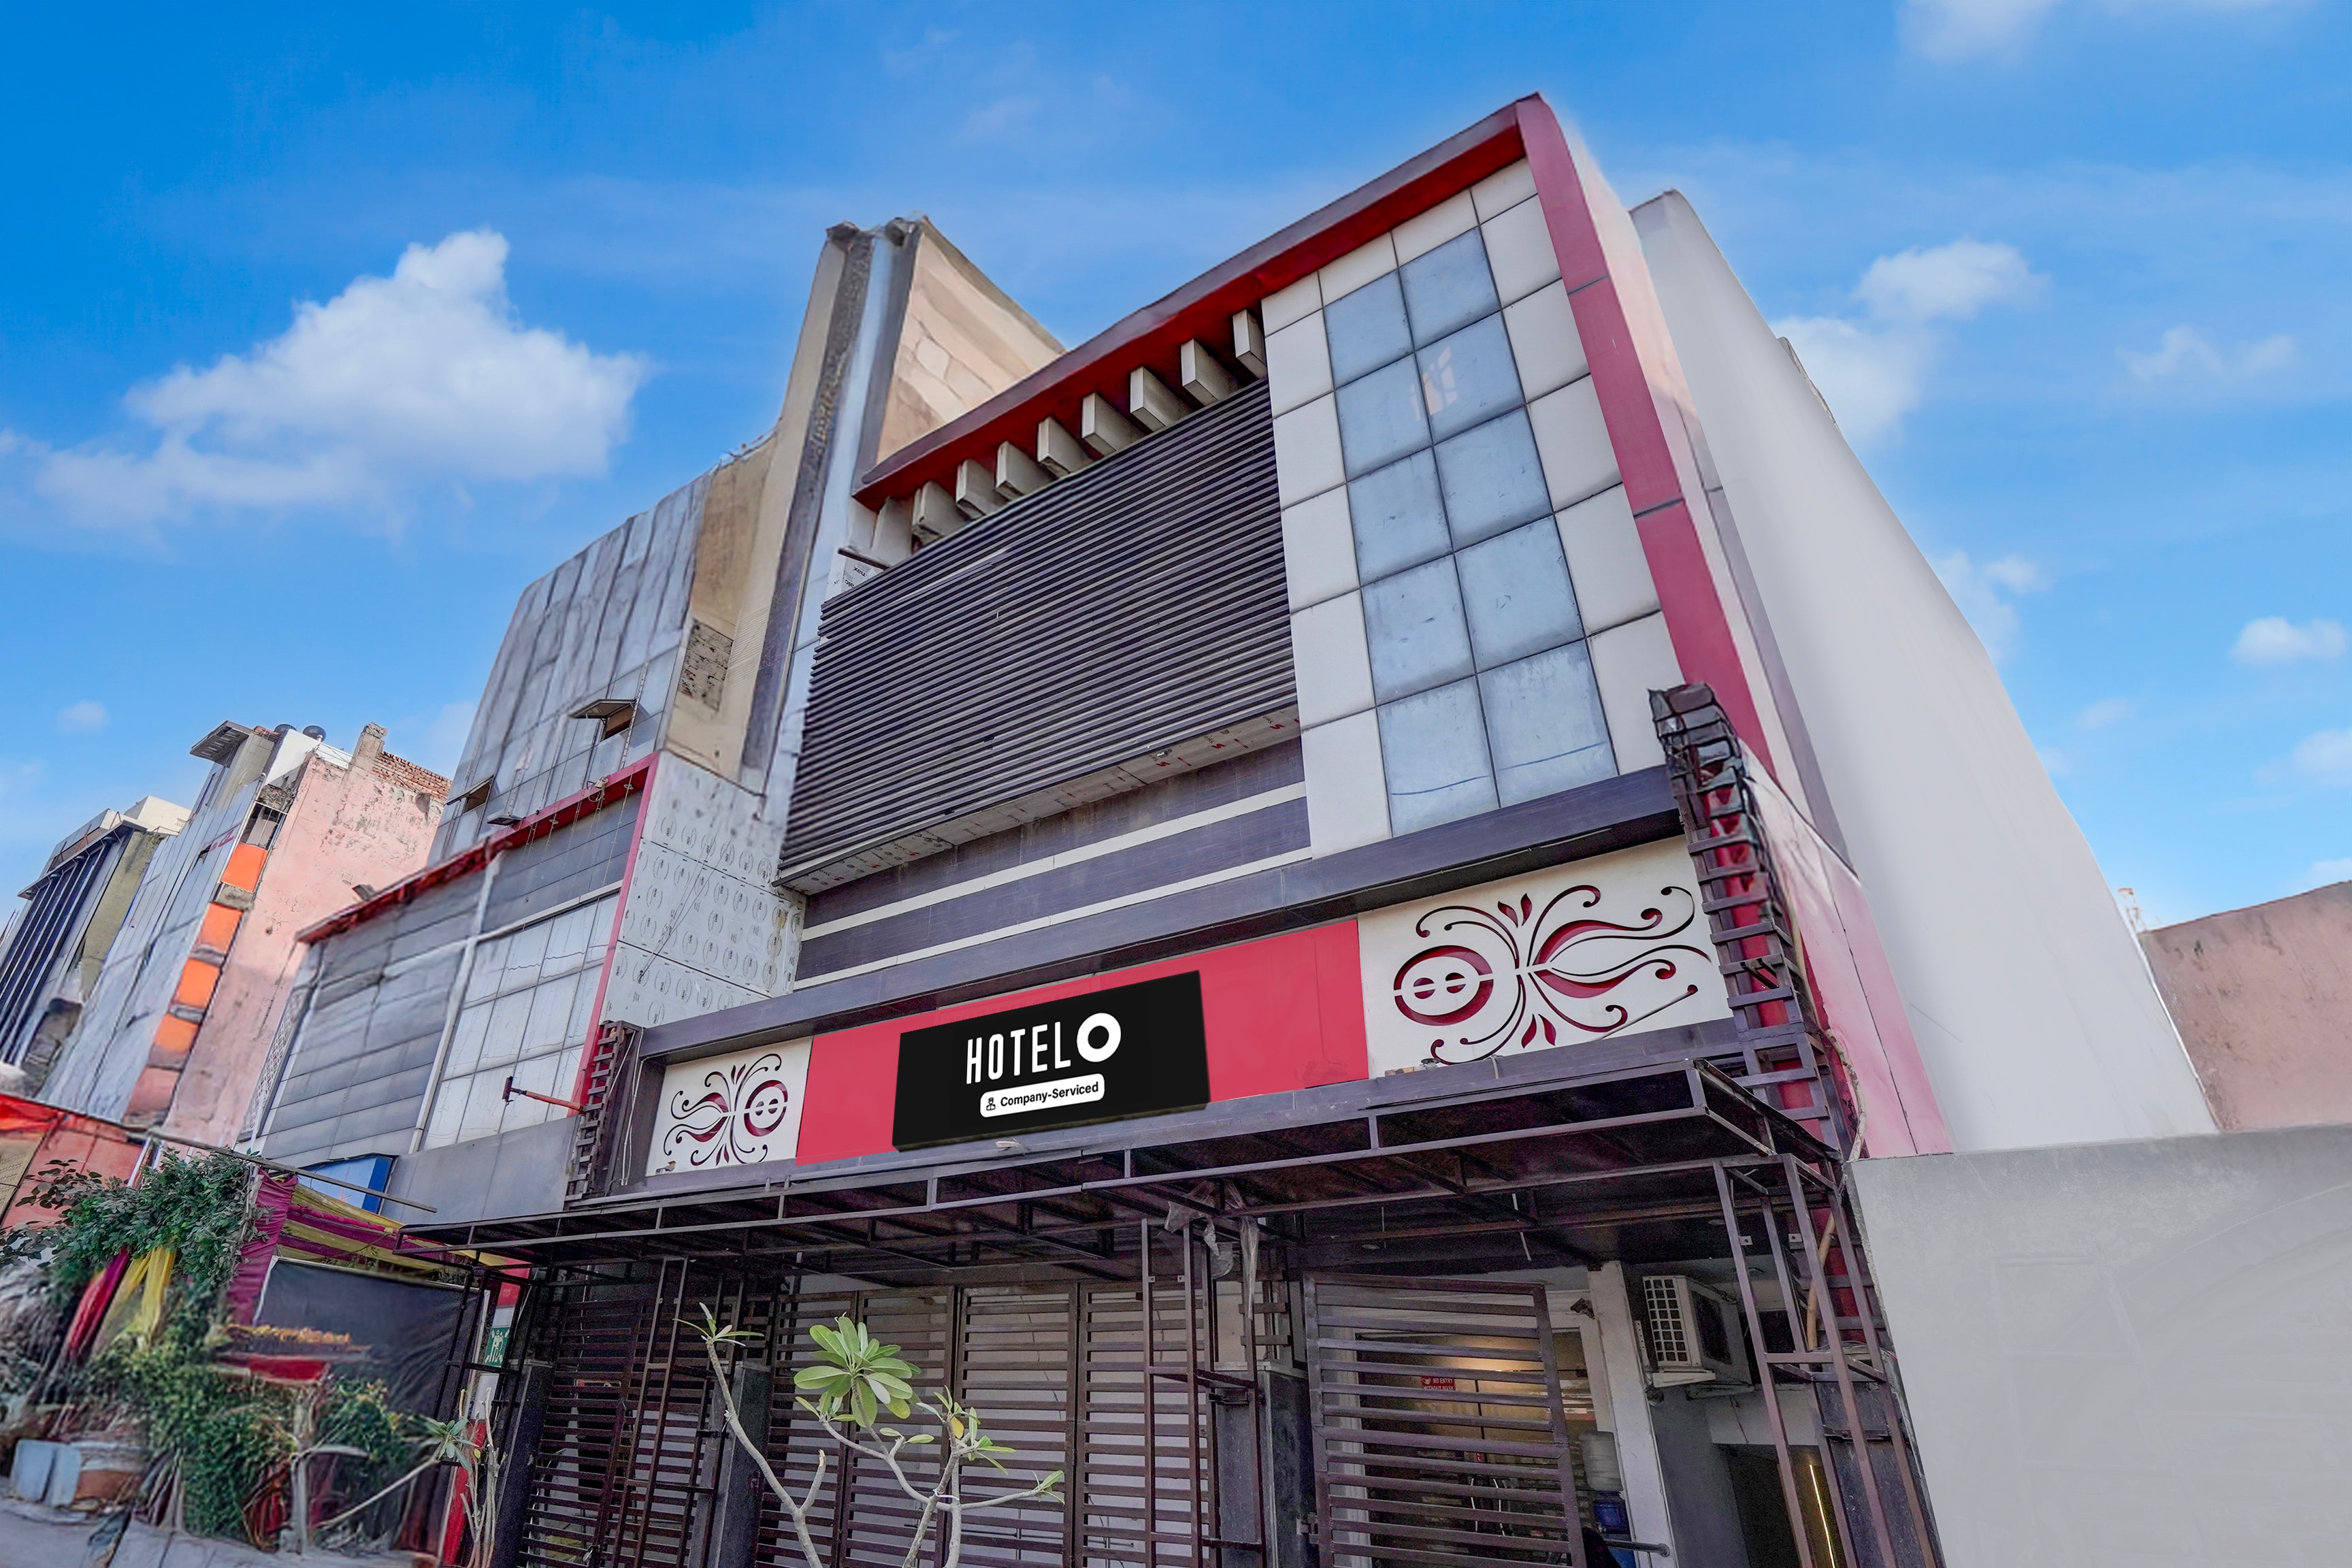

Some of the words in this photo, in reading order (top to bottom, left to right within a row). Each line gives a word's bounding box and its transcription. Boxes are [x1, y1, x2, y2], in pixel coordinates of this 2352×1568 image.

[966, 1021, 1071, 1085] HOTEL
[1077, 1013, 1122, 1062] O
[1000, 1081, 1099, 1107] Company-Serviced
